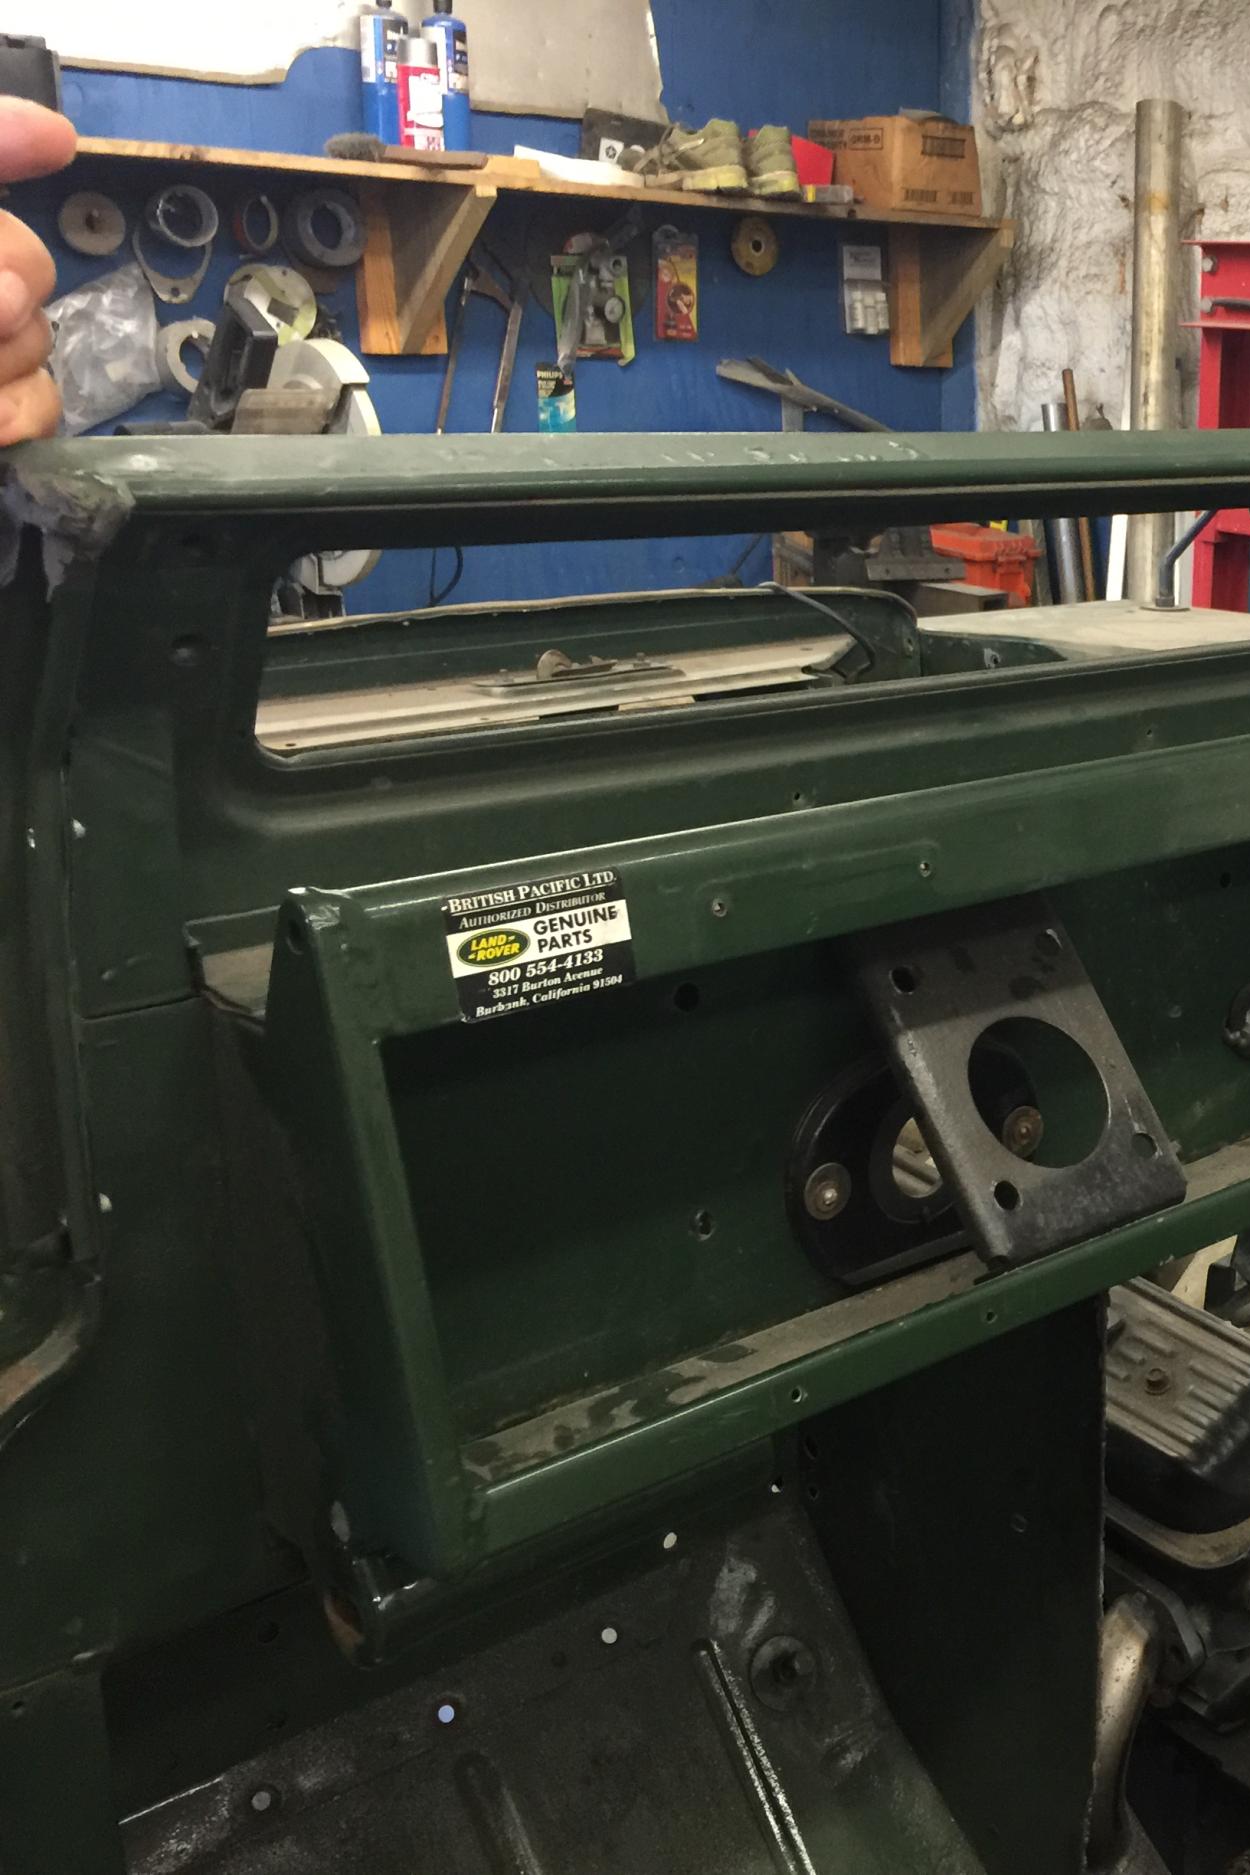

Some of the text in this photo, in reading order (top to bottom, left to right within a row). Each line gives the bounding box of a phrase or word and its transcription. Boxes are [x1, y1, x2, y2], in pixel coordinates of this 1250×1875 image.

[448, 889, 515, 913] BRITISH
[517, 877, 582, 900] PACIFIC
[458, 891, 606, 930] AUTHORIZED DISTRIBUTOR
[533, 905, 619, 936] GENUINE
[537, 929, 593, 953] PARTS
[488, 949, 604, 986] 800 554-4133
[521, 977, 562, 993] Burton
[563, 967, 603, 983] Avenue
[532, 983, 591, 1004] California
[592, 974, 623, 989] 91504
